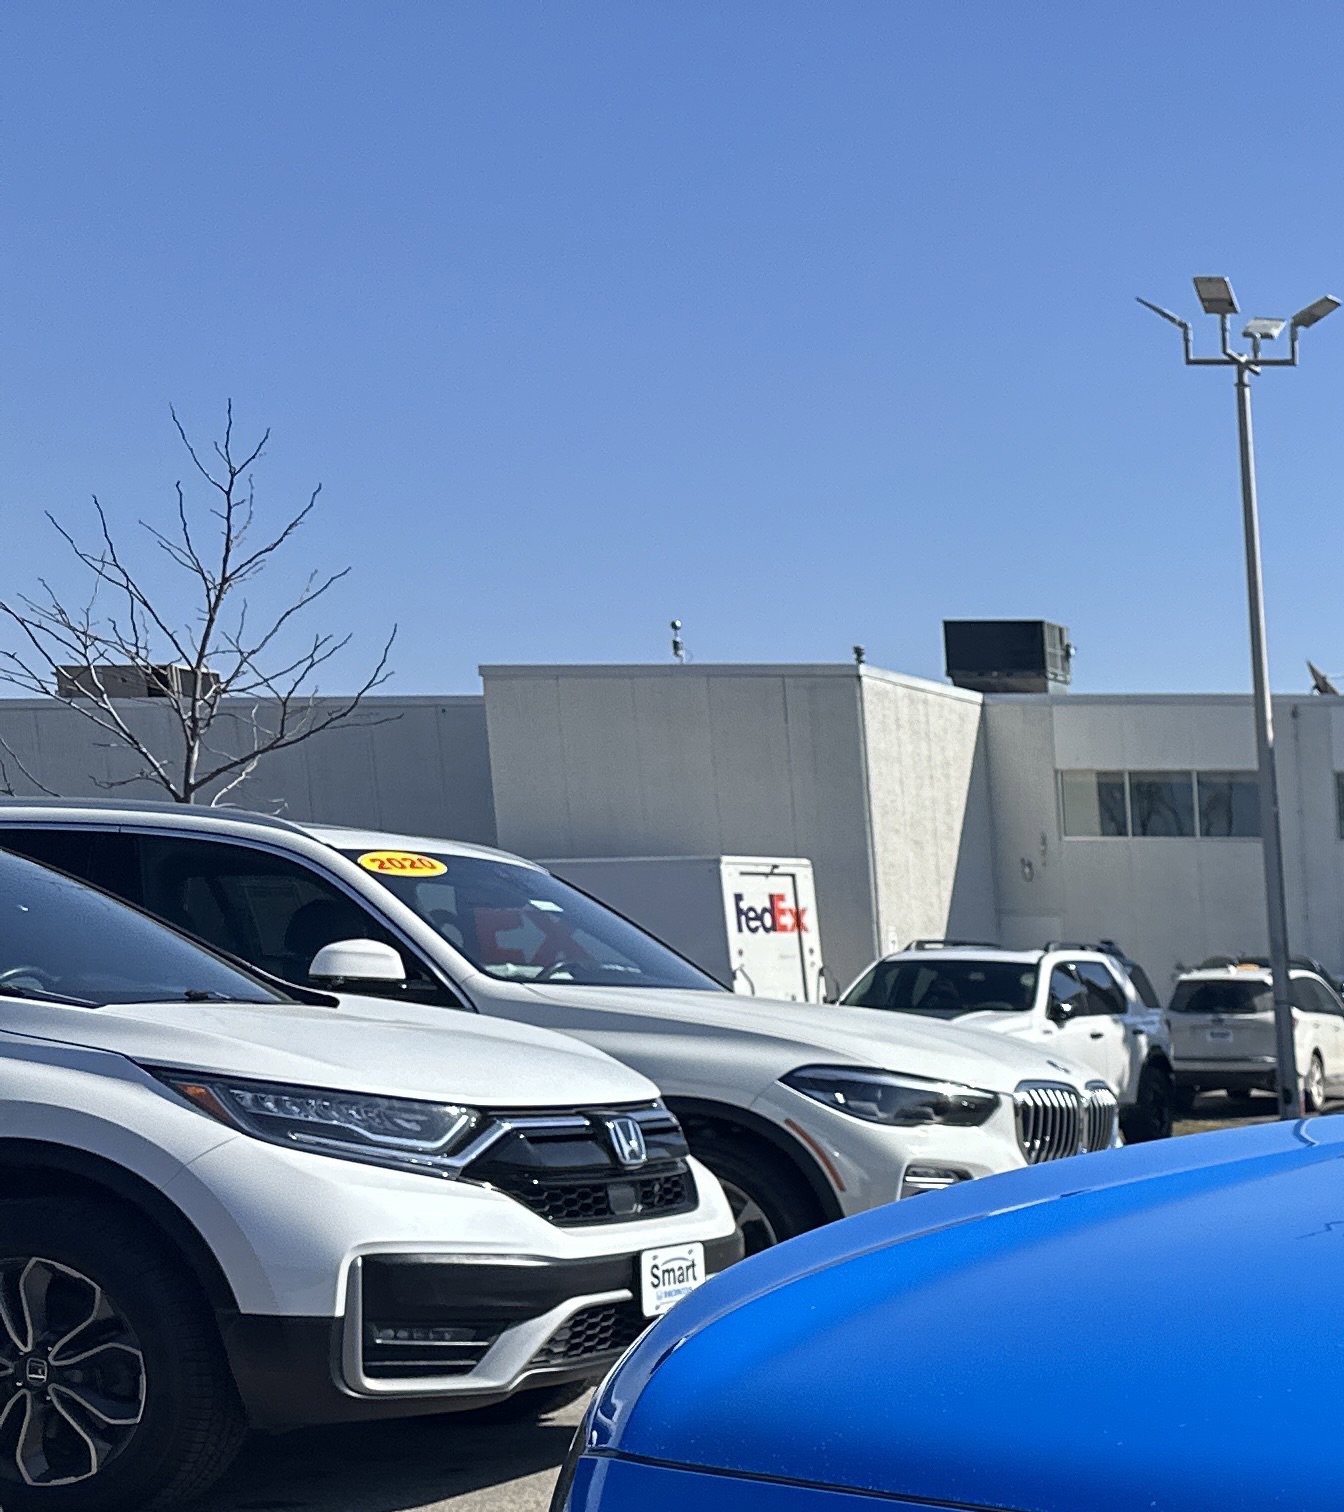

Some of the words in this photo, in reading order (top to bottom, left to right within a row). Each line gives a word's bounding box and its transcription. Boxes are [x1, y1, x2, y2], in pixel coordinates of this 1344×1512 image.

[369, 857, 437, 870] 2020
[734, 893, 808, 933] FedEx
[650, 1258, 697, 1289] Smart
